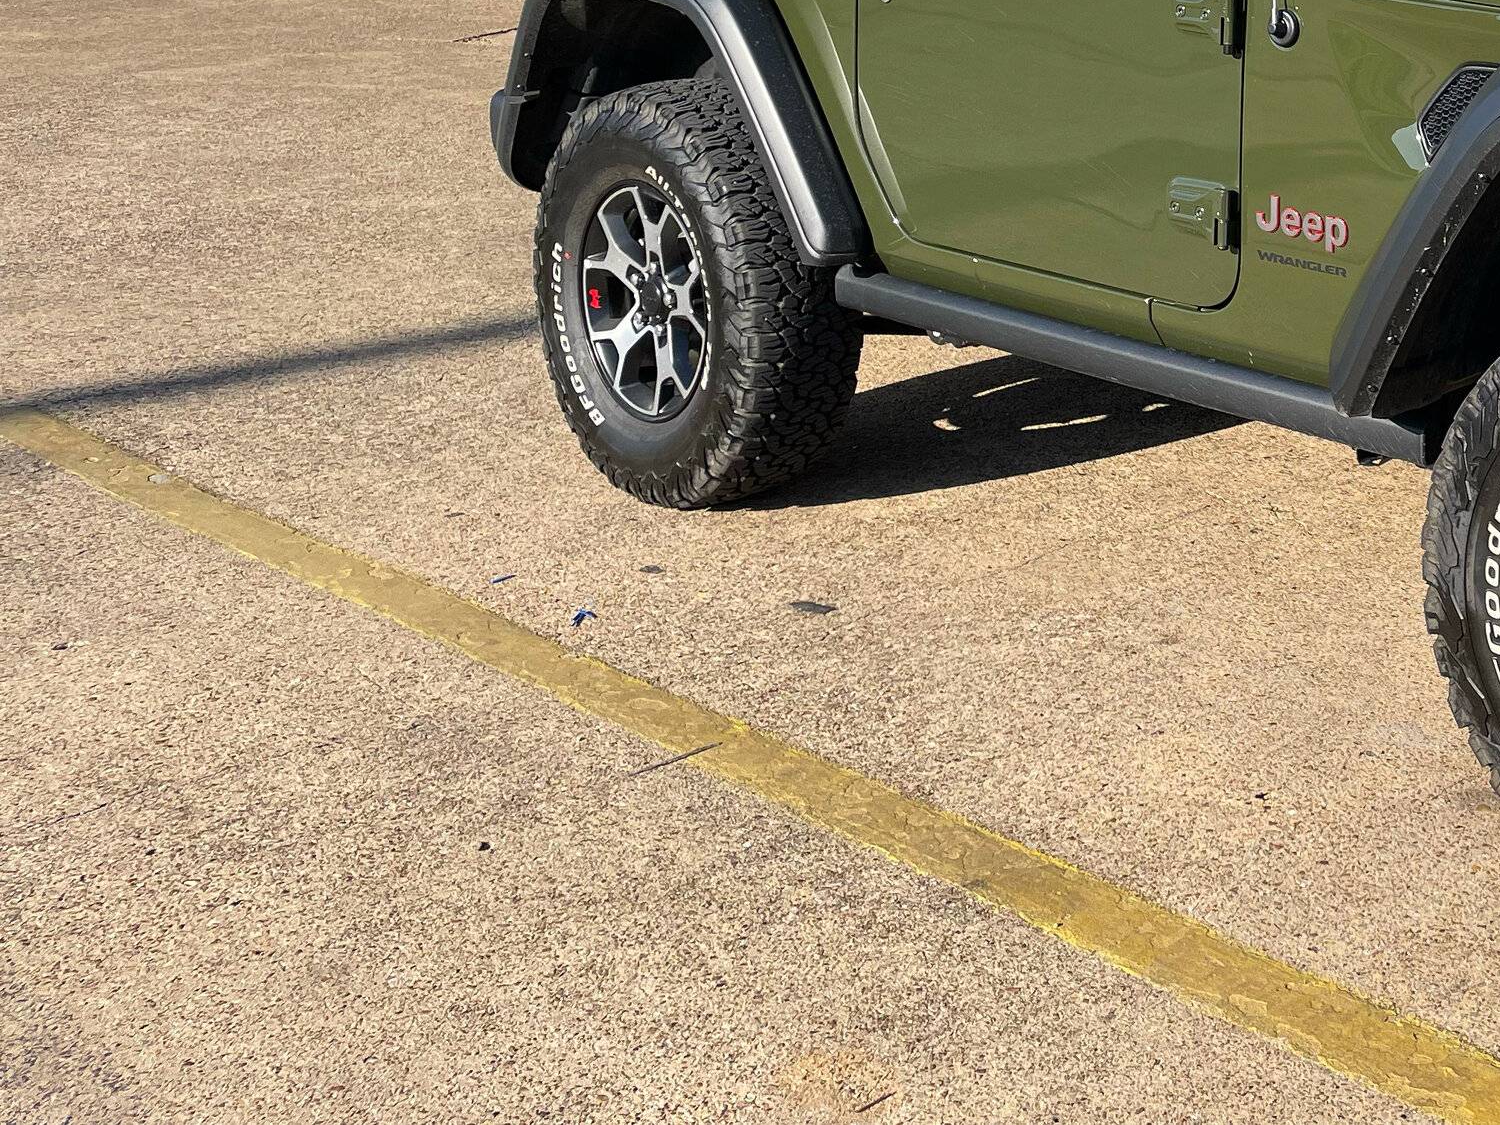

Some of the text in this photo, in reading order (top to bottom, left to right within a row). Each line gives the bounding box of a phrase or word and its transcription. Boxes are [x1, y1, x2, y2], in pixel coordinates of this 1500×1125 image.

[1255, 193, 1349, 254] Jeep
[1257, 249, 1348, 278] WRANGLER
[551, 241, 606, 426] BFGoodrich
